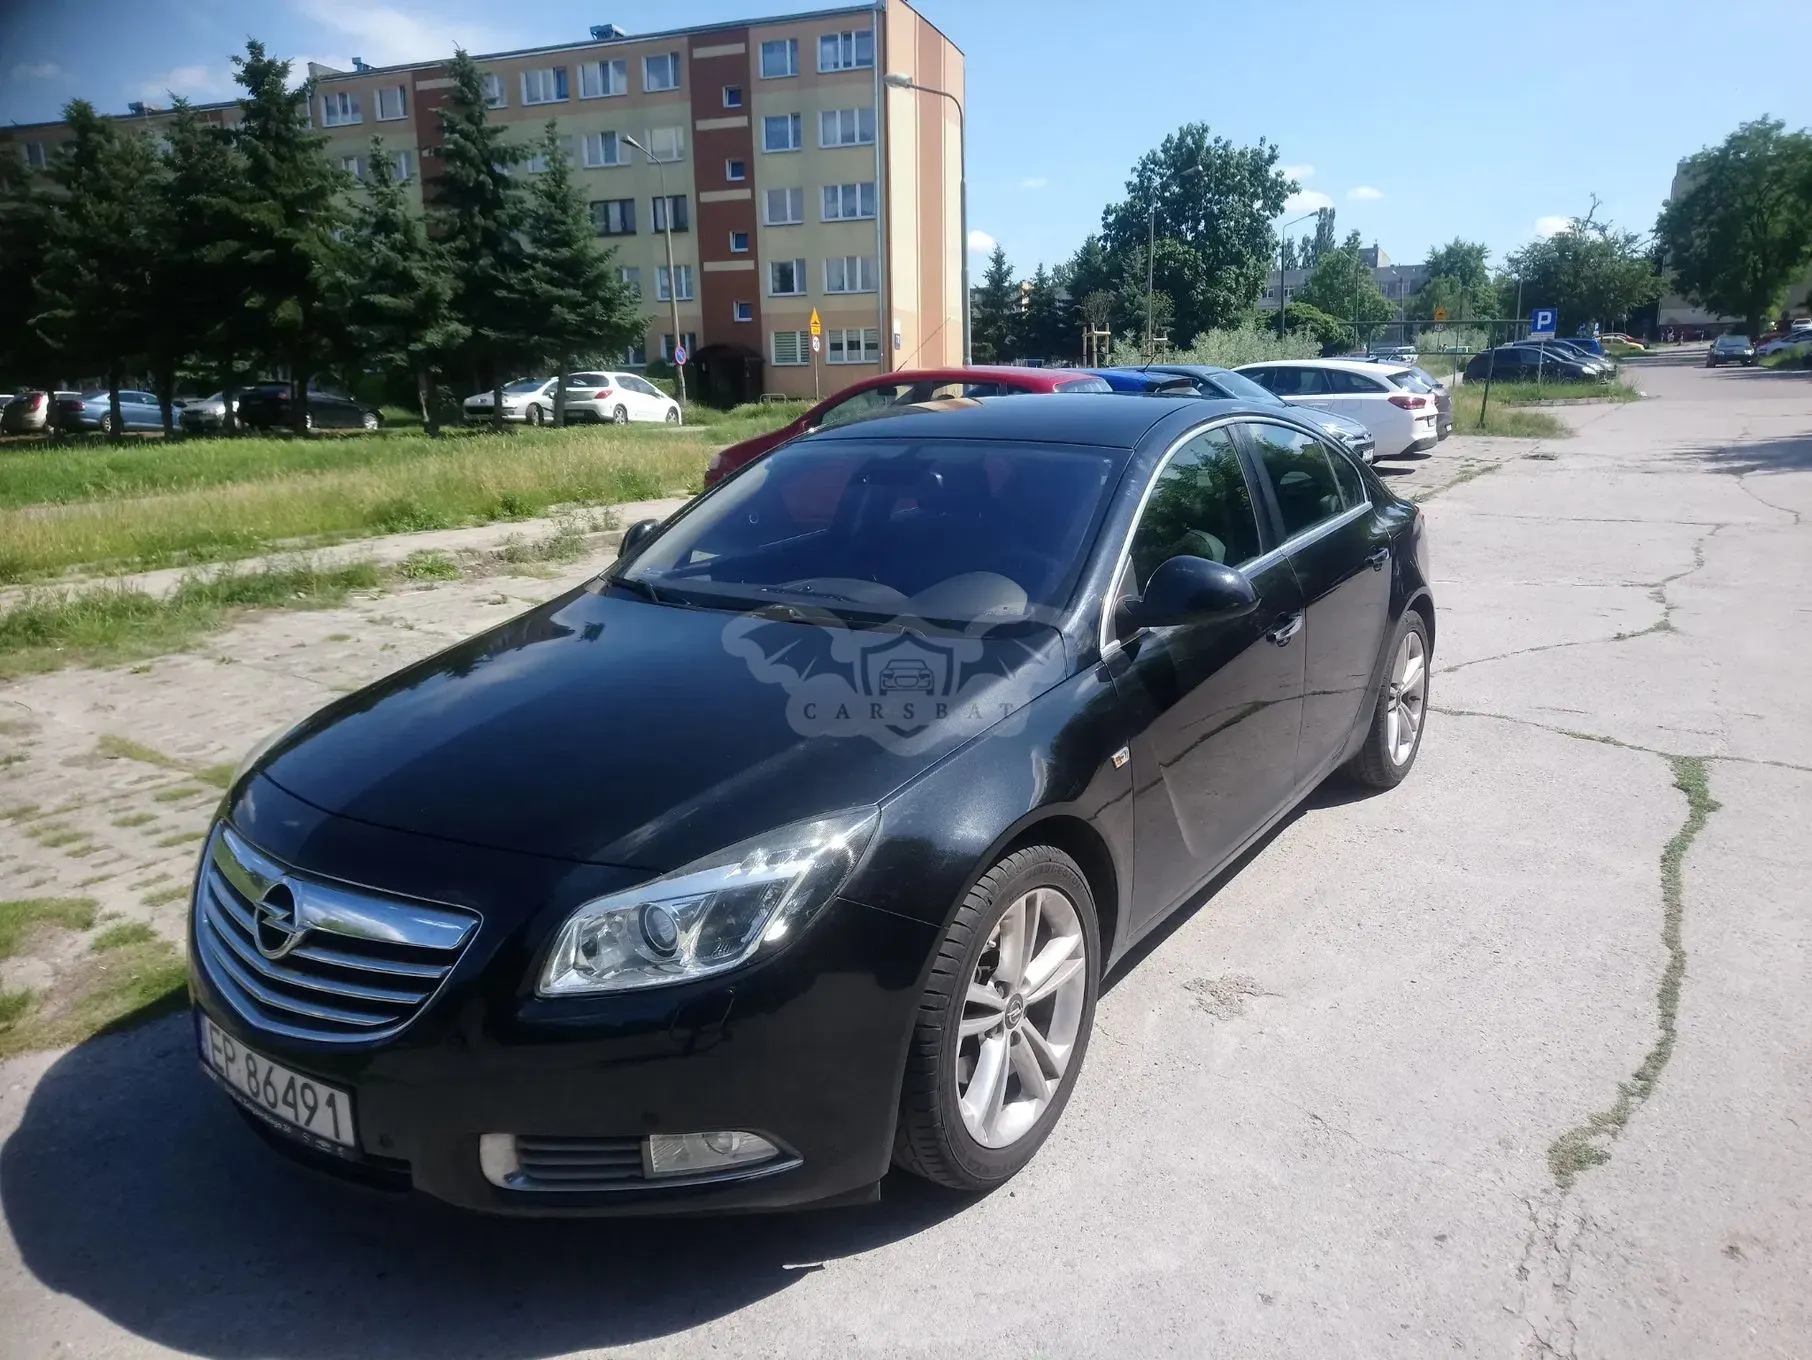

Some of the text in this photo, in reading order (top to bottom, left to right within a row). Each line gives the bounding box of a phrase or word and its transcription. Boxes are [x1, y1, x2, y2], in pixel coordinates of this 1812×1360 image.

[1537, 311, 1552, 330] P
[209, 1022, 236, 1080] EP
[244, 1052, 341, 1140] 86491
